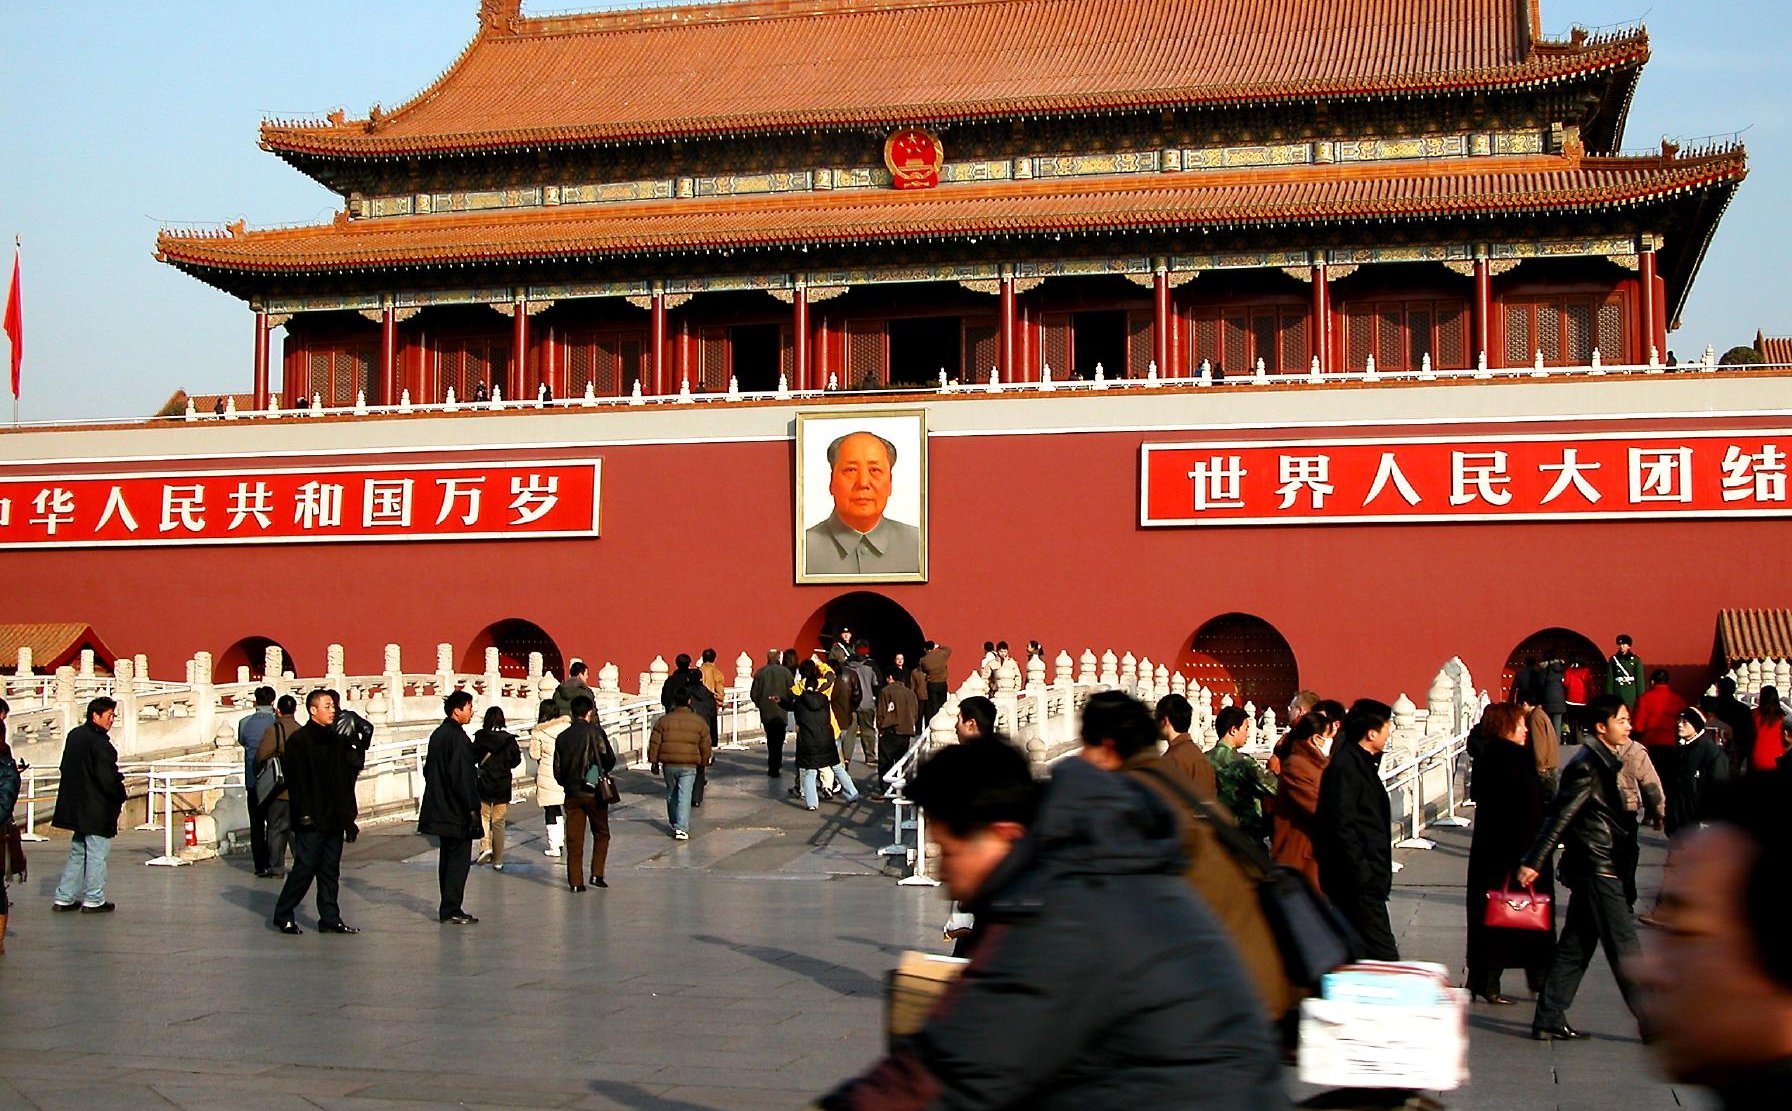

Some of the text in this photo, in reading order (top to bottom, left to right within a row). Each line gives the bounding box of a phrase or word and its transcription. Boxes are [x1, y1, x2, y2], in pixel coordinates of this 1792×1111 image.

[1187, 444, 1788, 511] 世界人民大团结
